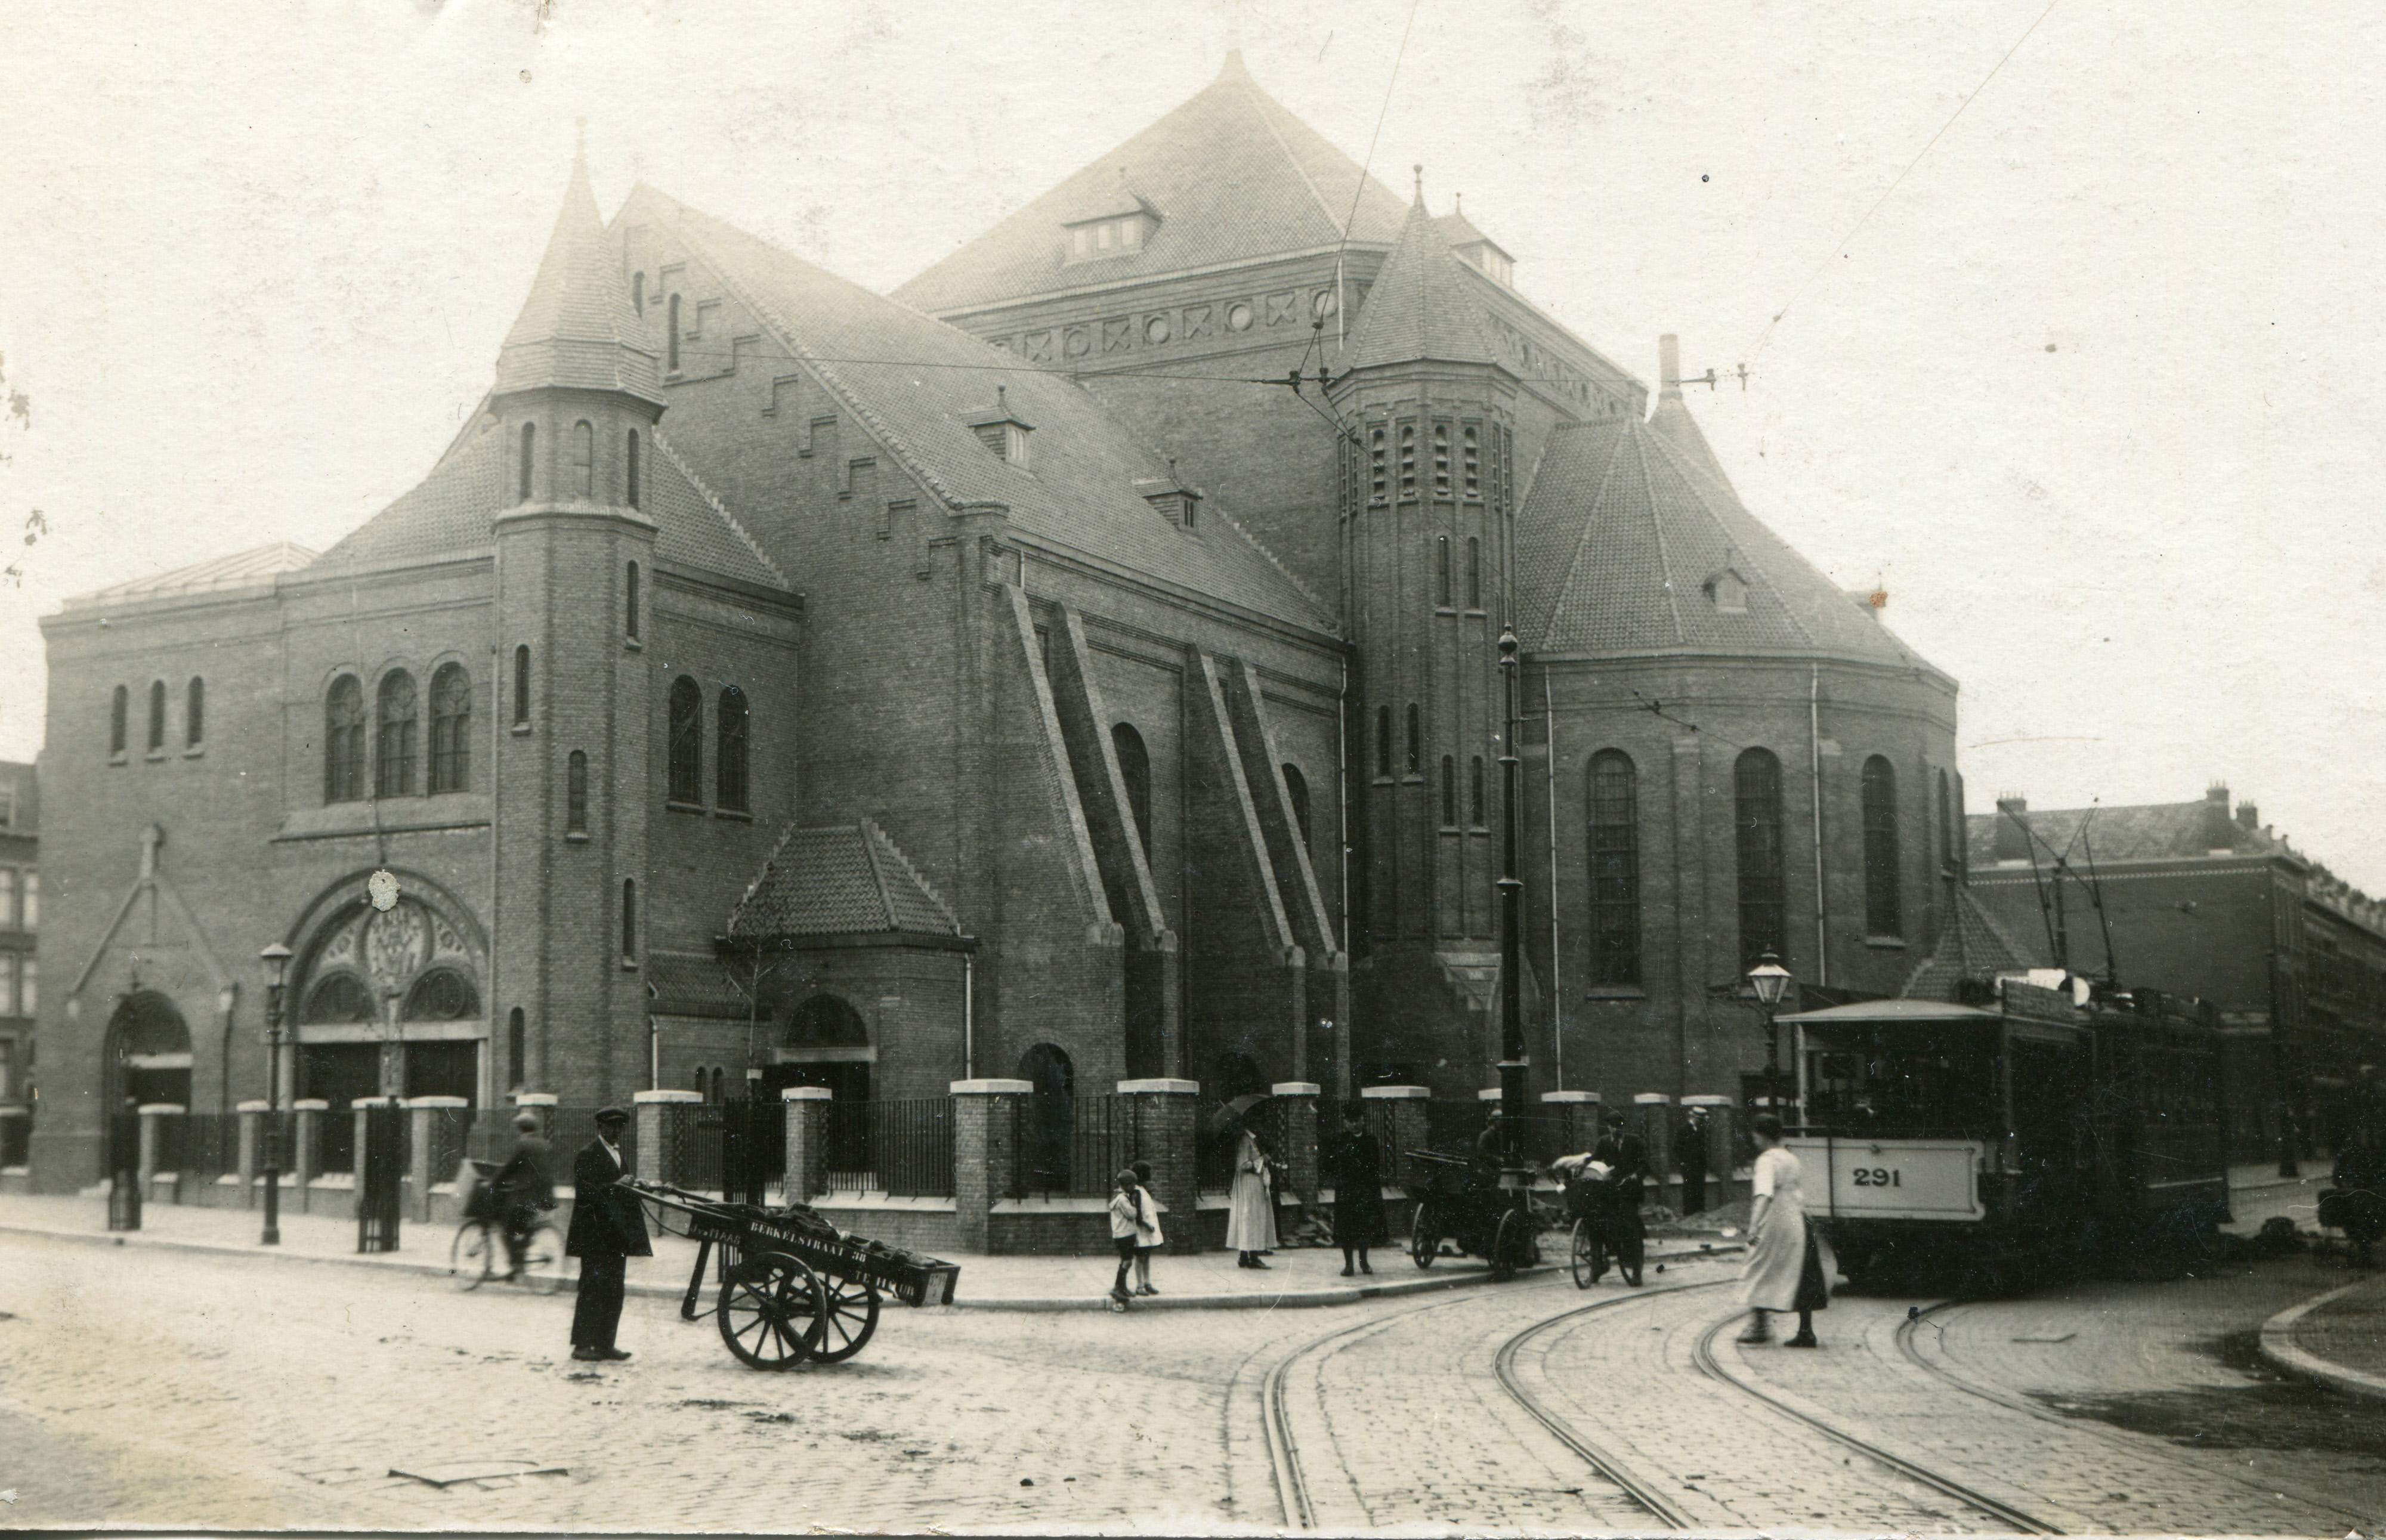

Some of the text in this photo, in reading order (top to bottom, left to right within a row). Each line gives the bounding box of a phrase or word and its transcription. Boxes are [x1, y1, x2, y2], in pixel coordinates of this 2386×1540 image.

[1853, 1167, 1902, 1188] 291
[709, 1227, 741, 1245] MAAS
[750, 1222, 867, 1263] BERKELSTRAAT 38
[855, 1270, 871, 1284] TE
